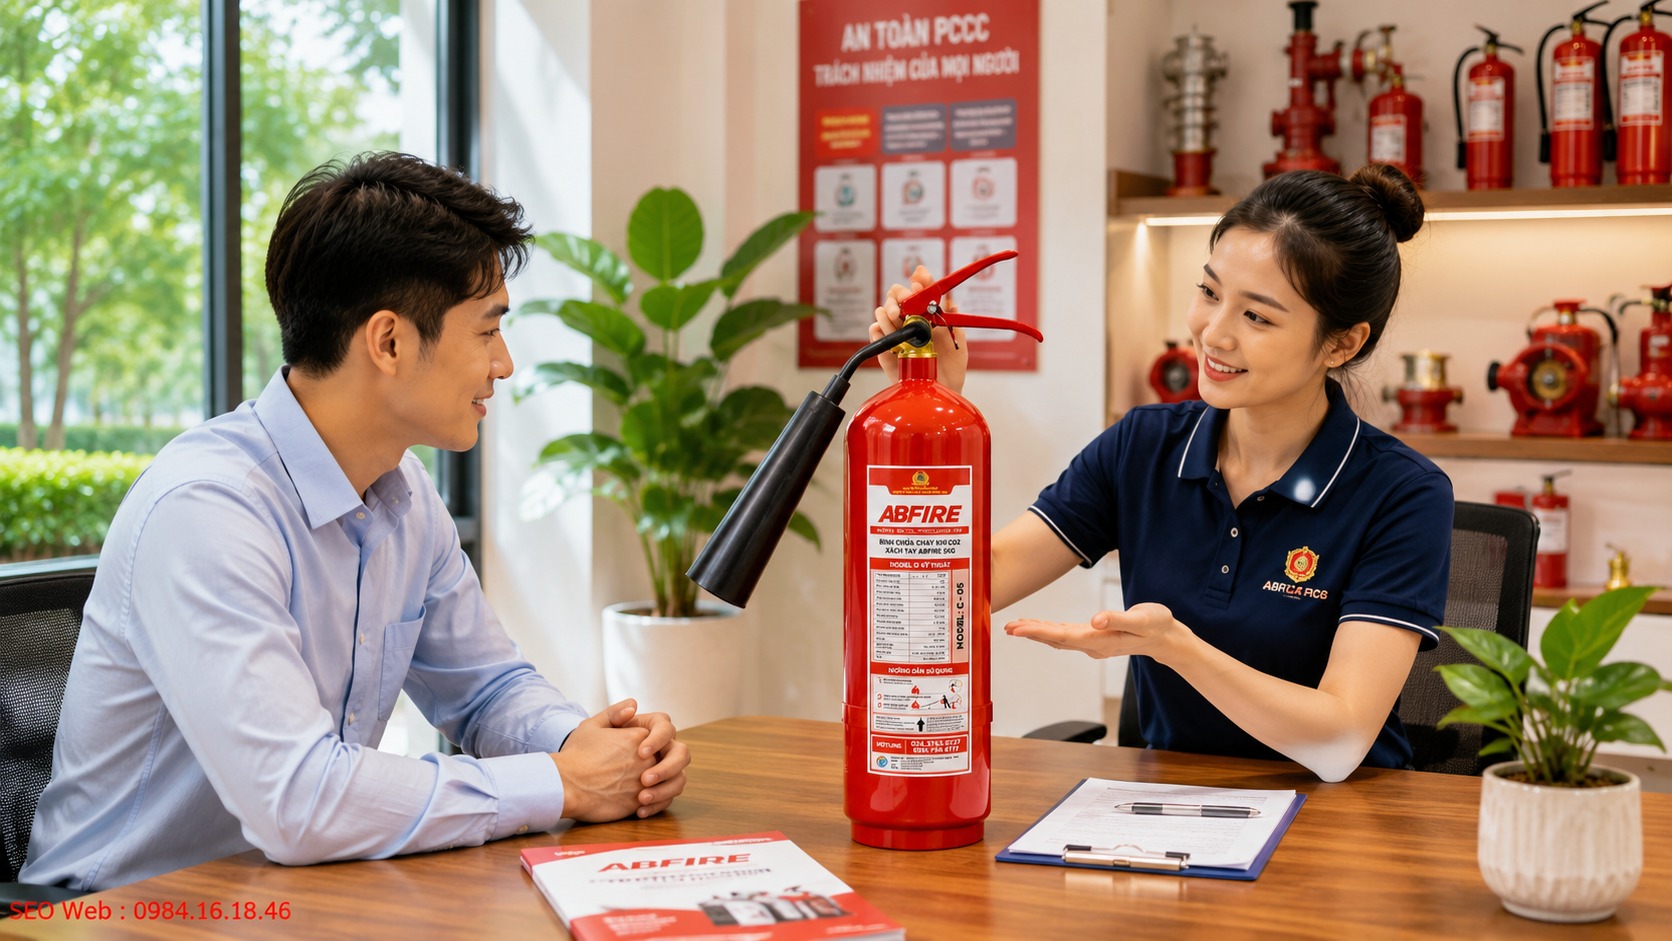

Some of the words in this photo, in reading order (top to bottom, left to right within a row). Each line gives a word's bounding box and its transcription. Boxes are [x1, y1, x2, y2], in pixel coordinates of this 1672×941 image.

[841, 23, 871, 52] AN
[875, 13, 930, 49] TOÀN
[934, 13, 990, 45] PCCC
[814, 59, 860, 86] TRÁCH
[909, 51, 939, 80] CỦA
[941, 55, 969, 83] MỌI
[878, 505, 962, 523] ABFIRE
[598, 854, 751, 872] ABFIRE
